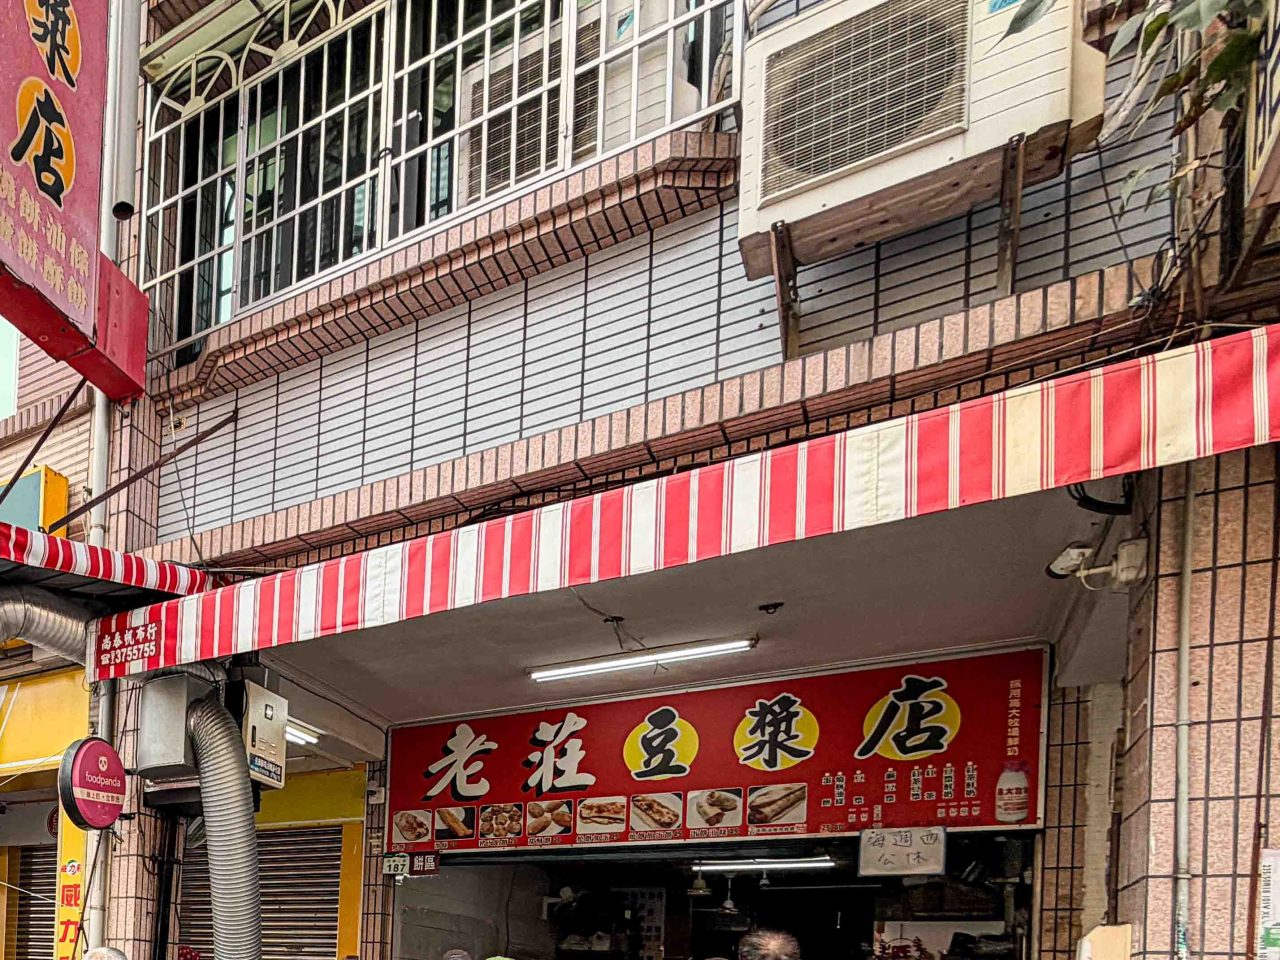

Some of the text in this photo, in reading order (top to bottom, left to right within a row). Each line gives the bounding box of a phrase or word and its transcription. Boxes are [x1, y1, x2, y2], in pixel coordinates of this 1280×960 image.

[116, 641, 156, 664] 3755755
[426, 675, 949, 800] 老莊豆漿店
[86, 771, 121, 787] foodpanda
[387, 863, 406, 873] 187
